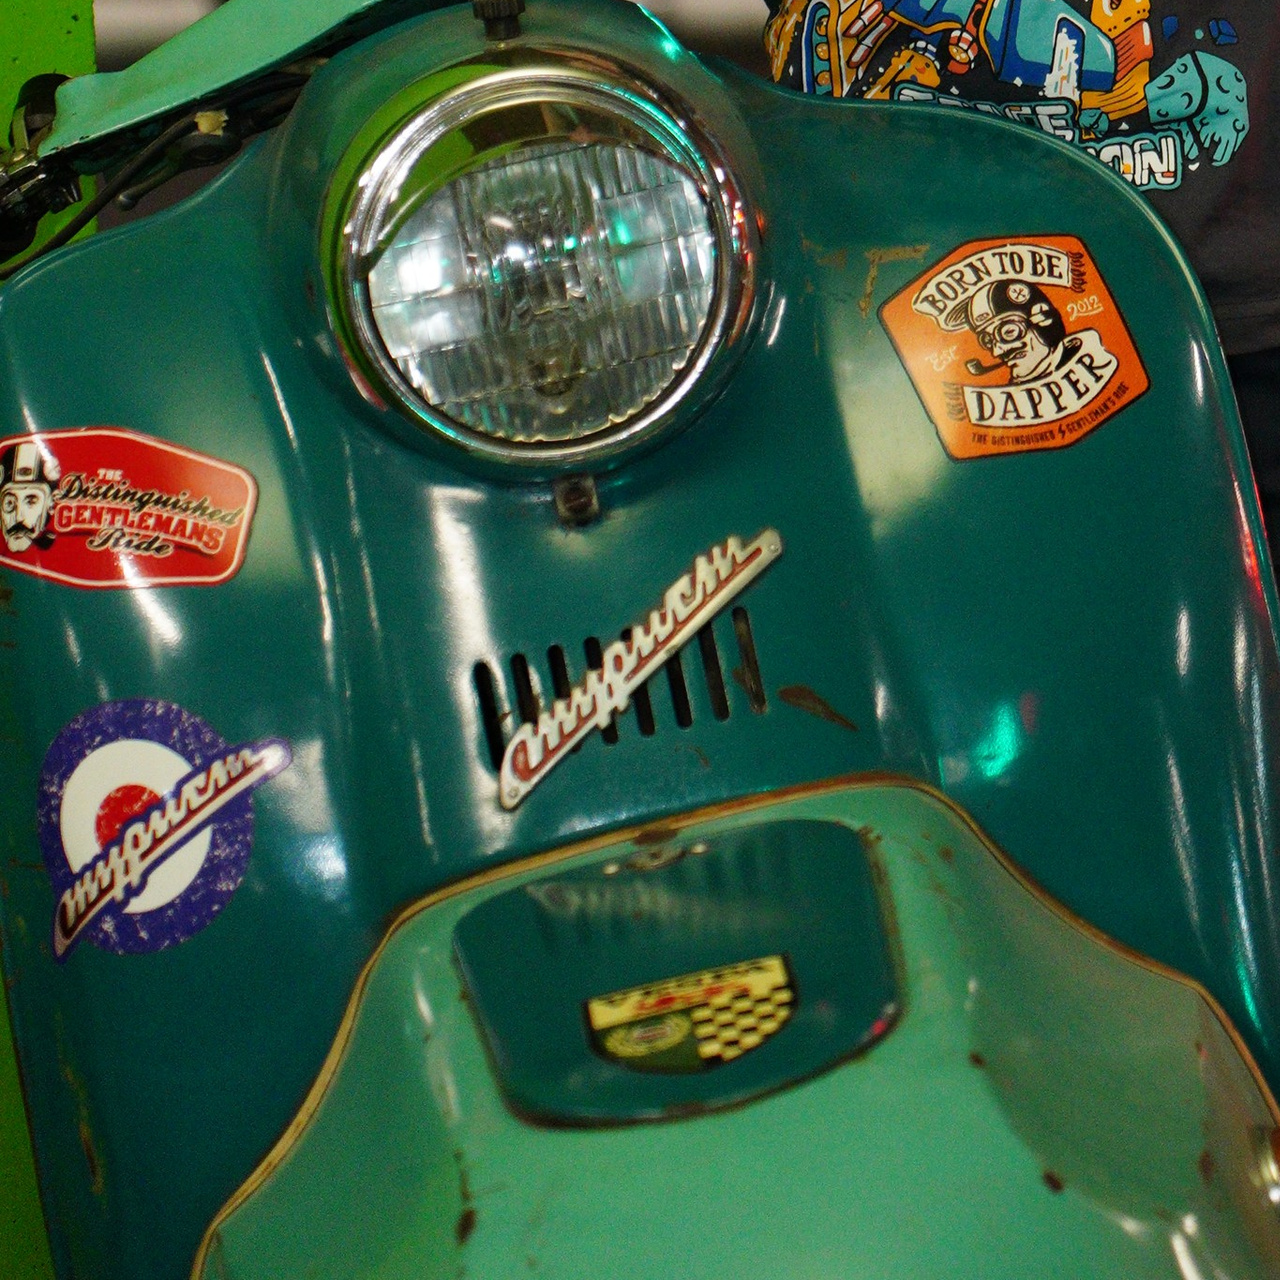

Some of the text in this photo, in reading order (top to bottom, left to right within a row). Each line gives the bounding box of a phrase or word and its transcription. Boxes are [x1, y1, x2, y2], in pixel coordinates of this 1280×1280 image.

[919, 250, 1064, 317] BORN TO BE
[1066, 295, 1104, 321] 2012
[970, 353, 1112, 422] DAPPER
[971, 432, 987, 445] THE
[97, 468, 123, 480] THE
[53, 471, 246, 526] Distinguished
[56, 503, 225, 551] GENTLEMANS
[87, 528, 174, 557] Ride
